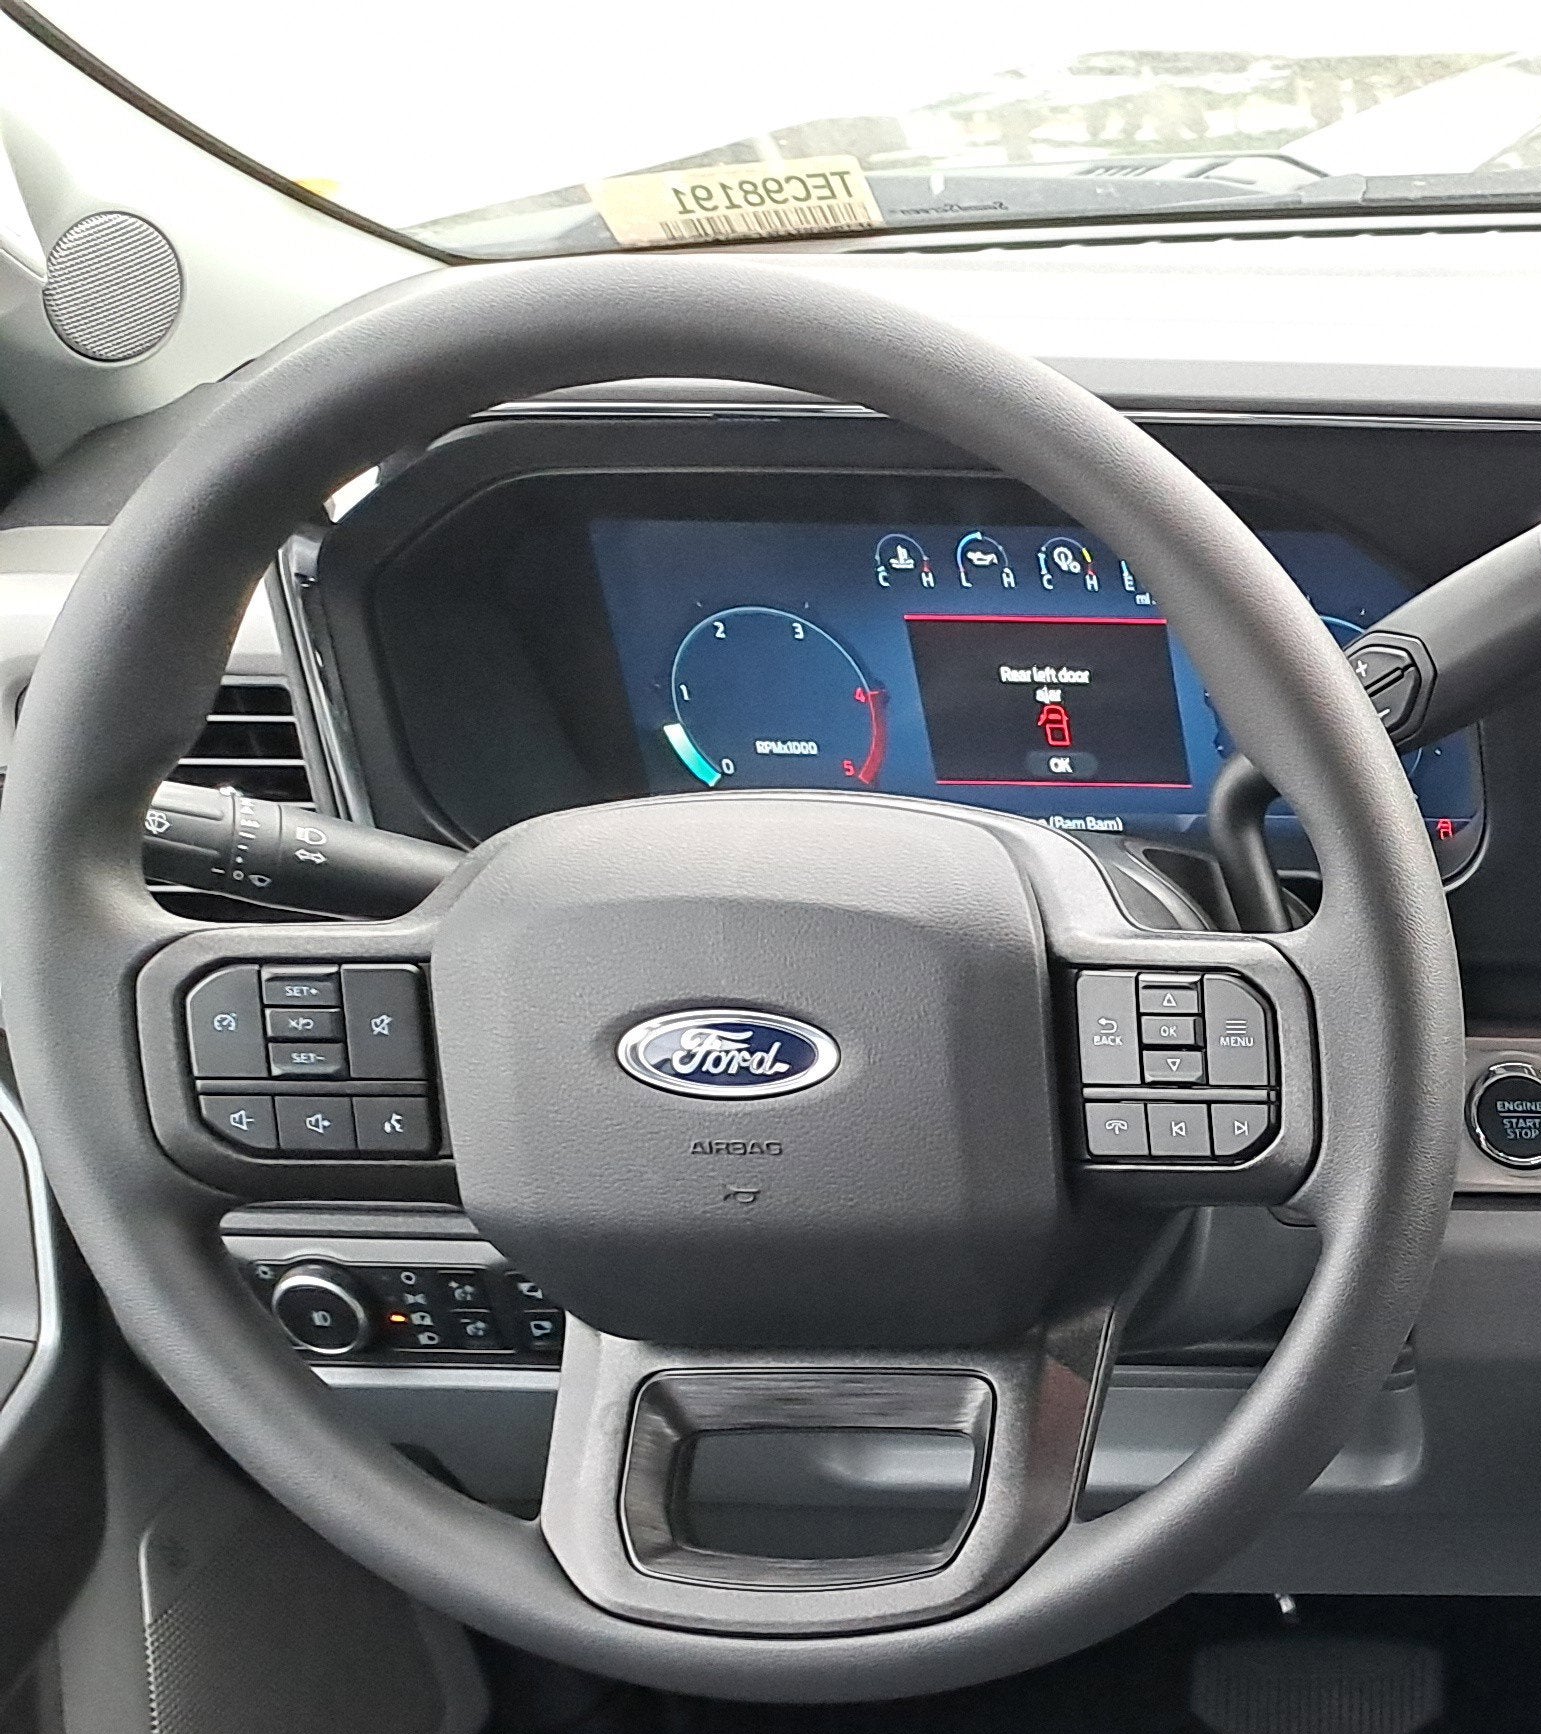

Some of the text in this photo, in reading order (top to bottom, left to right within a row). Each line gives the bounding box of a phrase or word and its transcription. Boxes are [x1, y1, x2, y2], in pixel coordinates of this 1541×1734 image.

[921, 571, 935, 588] H
[713, 622, 726, 639] 2
[792, 622, 804, 639] 3
[1000, 665, 1090, 684] Rear left door
[679, 684, 690, 701] 1
[855, 686, 866, 703] 4
[721, 759, 735, 774] 0
[843, 760, 855, 776] 5
[1049, 757, 1073, 773] OK
[1160, 1026, 1178, 1038] OK
[1093, 1035, 1123, 1047] BACK
[1219, 1036, 1254, 1047] MENU
[671, 1028, 791, 1075] Ford
[1503, 1118, 1541, 1129] START
[1507, 1128, 1541, 1140] STOP
[690, 1140, 784, 1156] AIRBAG
